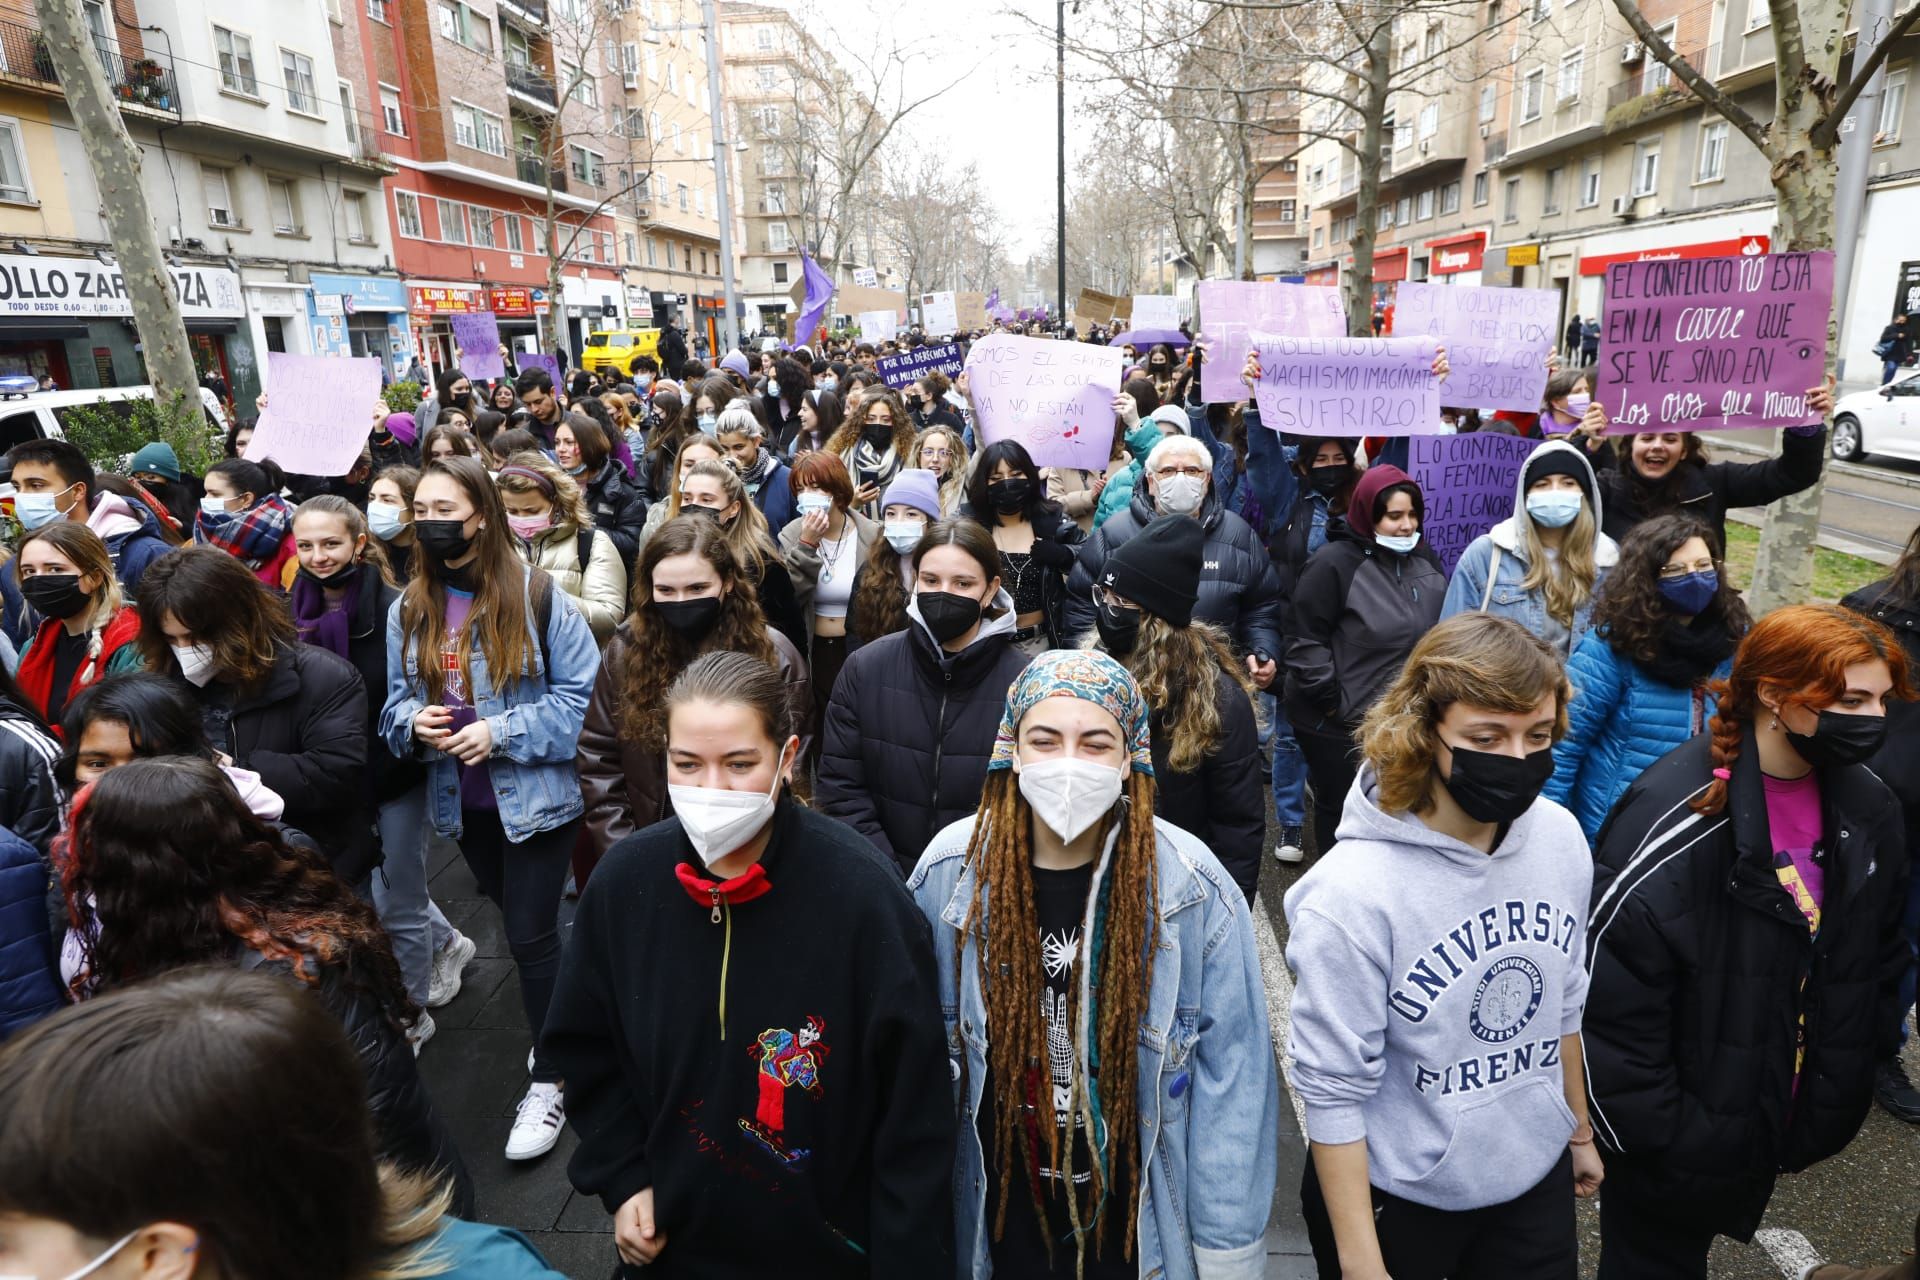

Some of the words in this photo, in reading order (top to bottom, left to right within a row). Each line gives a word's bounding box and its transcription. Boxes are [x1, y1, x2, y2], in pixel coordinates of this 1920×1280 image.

[74, 271, 212, 308] ZARZA
[1611, 264, 1634, 299] EL
[1643, 259, 1733, 297] CONFLICTO
[8, 302, 29, 311] TODO
[34, 303, 59, 311] DESDE
[424, 288, 446, 301] KING
[1413, 287, 1435, 313] SI
[1456, 291, 1549, 317] VOLVEMOS
[1426, 316, 1449, 336] AL
[1470, 319, 1550, 342] MEDIEVOX
[1608, 309, 1637, 344] EN
[1642, 308, 1662, 343] LA
[1675, 306, 1744, 343] carne
[1756, 303, 1796, 339] QUE
[883, 358, 899, 370] POR
[900, 355, 913, 365] LOS
[914, 347, 947, 363] DERECHOS
[947, 345, 957, 355] DE
[968, 346, 1020, 364] SOMOS
[1032, 351, 1057, 366] EL
[1071, 353, 1115, 368] GRITO
[1512, 350, 1544, 372] CON
[1608, 351, 1637, 384] SE
[1742, 347, 1775, 384] EN
[886, 374, 899, 385] LAS
[900, 366, 929, 381] MUJERES
[938, 359, 962, 375] NIÑAS
[989, 370, 1013, 387] DE
[1026, 374, 1055, 387] LAS
[1064, 374, 1096, 386] QUE
[1257, 364, 1359, 388] MACHISMO
[1363, 363, 1435, 392] IMAGÍNATE
[979, 397, 994, 413] YA
[1009, 399, 1029, 413] NO
[1036, 397, 1084, 416] ESTÁN
[1276, 394, 1427, 428] SUFRIRLO!
[1611, 388, 1651, 425] Los
[1721, 390, 1752, 425] que
[1416, 439, 1442, 464] LO
[1450, 435, 1533, 463] CONTRARI
[1415, 469, 1436, 492] AL
[1443, 463, 1517, 489] FEMINIS
[1434, 496, 1453, 522] LA
[1459, 493, 1515, 520] IGNOR
[1425, 522, 1490, 547] EREMOS
[1204, 561, 1219, 570] HH
[1389, 900, 1577, 1024] UNIVERSIT
[1472, 979, 1489, 1013] STUDI
[1490, 958, 1542, 994] UNIVERSITARI
[1415, 1038, 1560, 1095] FIRENZ
